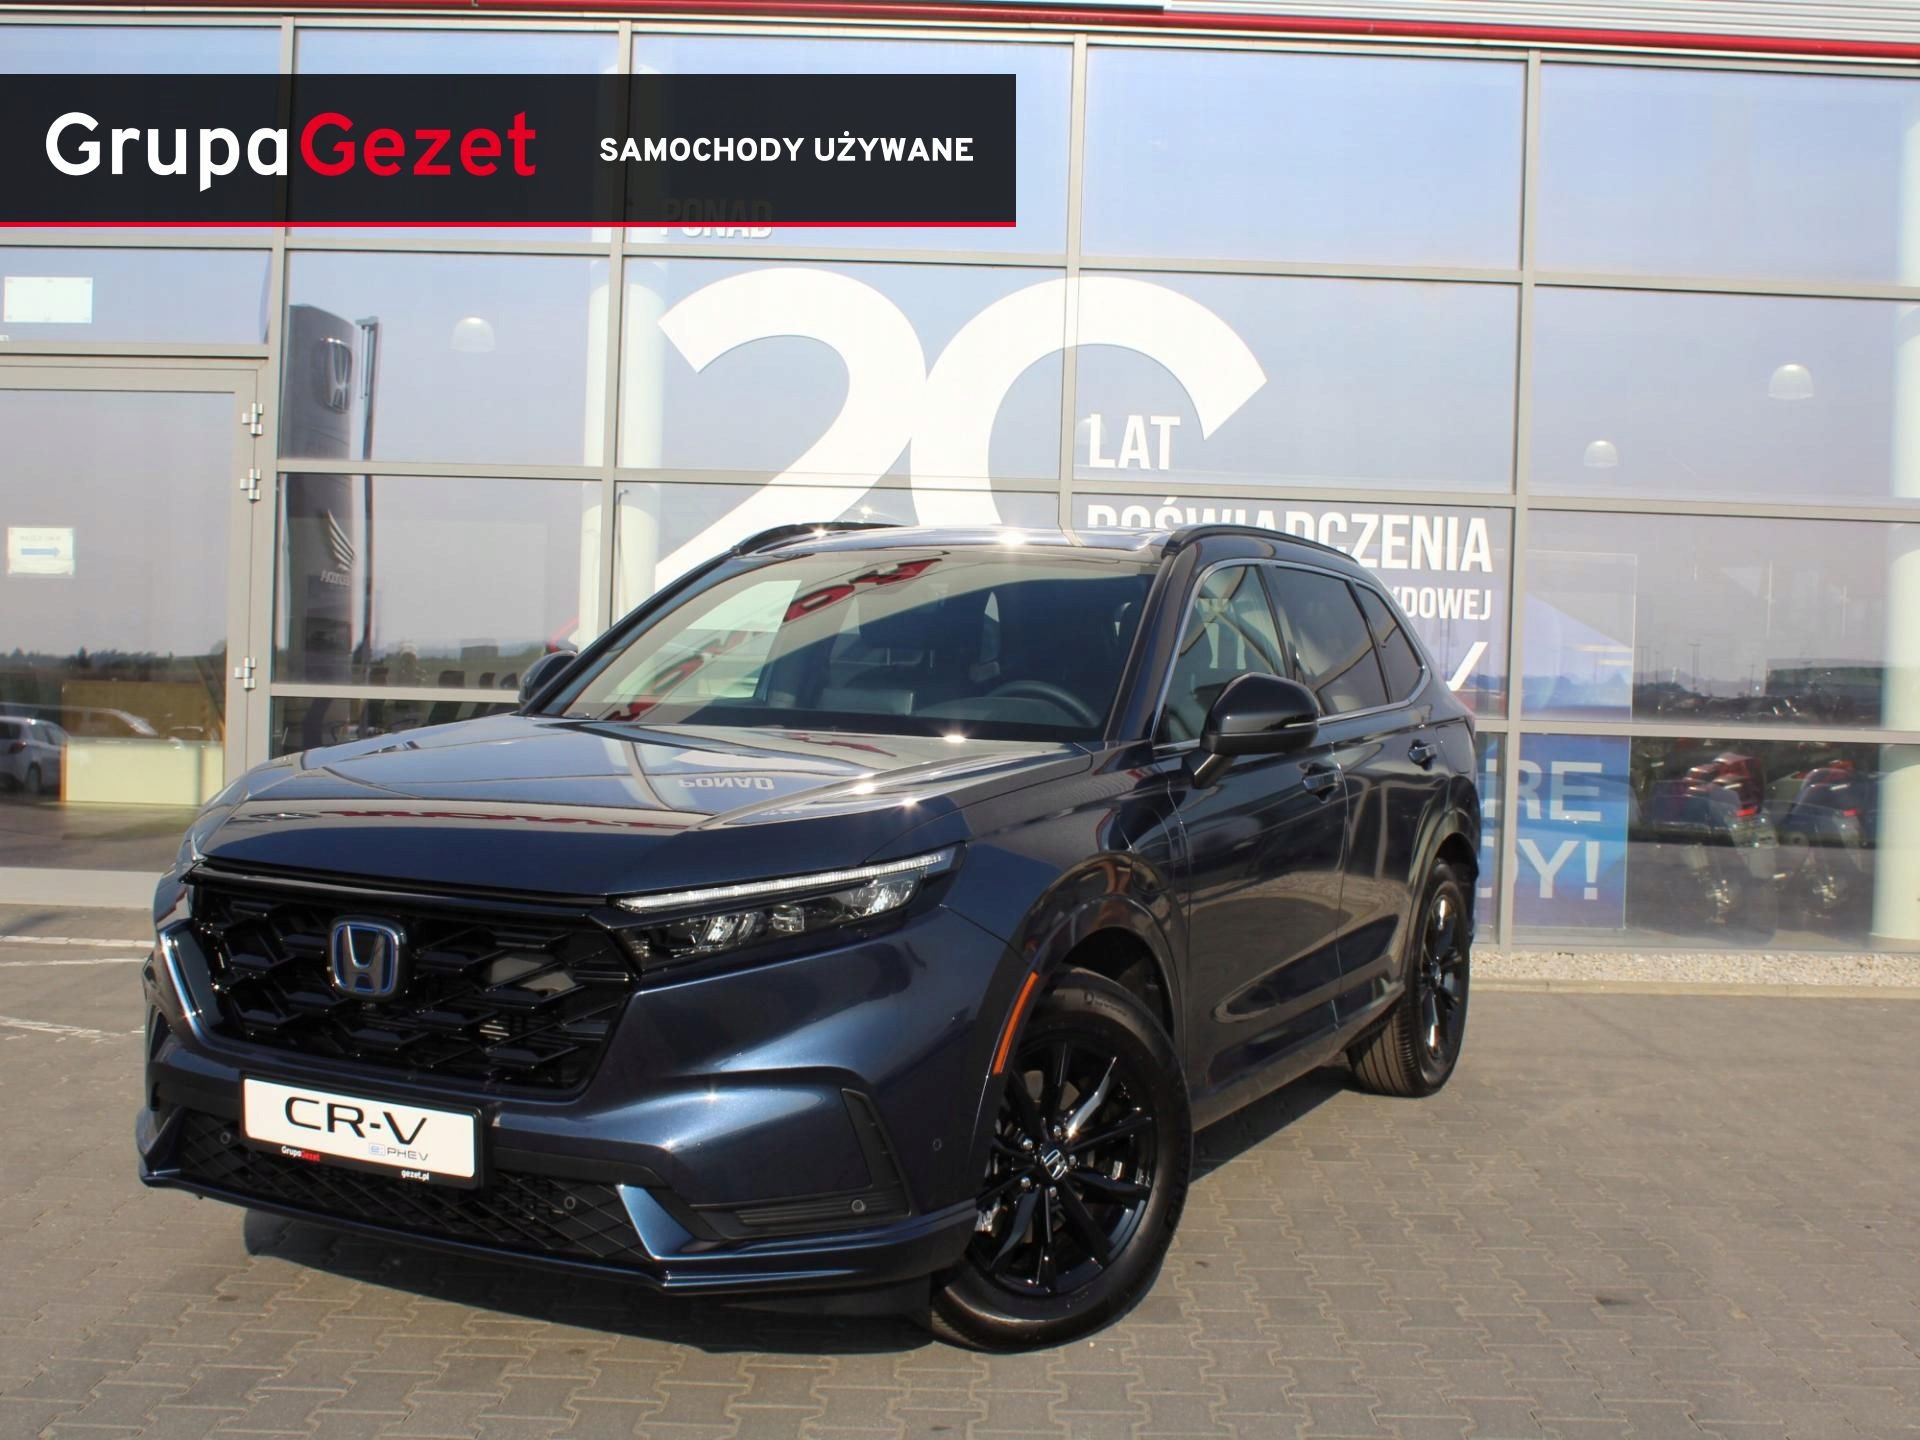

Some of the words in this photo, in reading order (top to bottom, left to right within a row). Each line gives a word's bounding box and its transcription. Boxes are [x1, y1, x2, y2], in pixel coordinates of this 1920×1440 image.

[1088, 413, 1181, 470] LAT
[1087, 496, 1493, 573] ŚDCZENIA
[1391, 586, 1492, 621] DOWEJ
[285, 1096, 427, 1146] CR-V
[401, 1169, 430, 1181] gezet.pl
